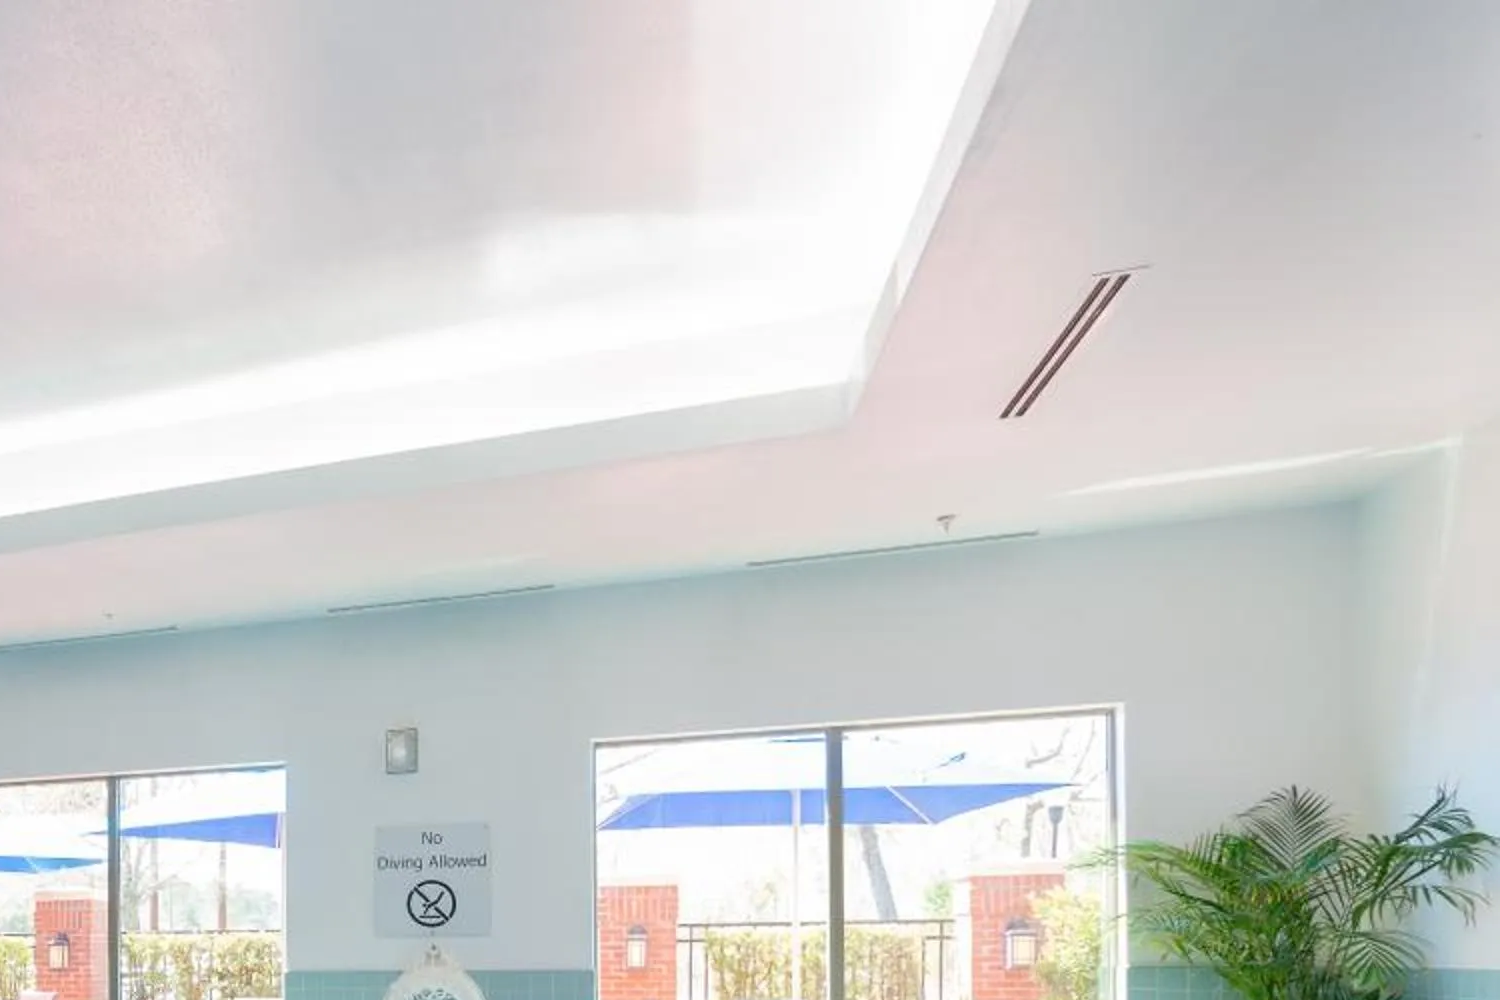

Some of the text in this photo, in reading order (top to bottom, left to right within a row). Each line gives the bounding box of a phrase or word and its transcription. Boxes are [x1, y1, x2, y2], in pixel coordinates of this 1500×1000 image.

[421, 831, 443, 845] No
[377, 853, 487, 872] Diving Allowed
